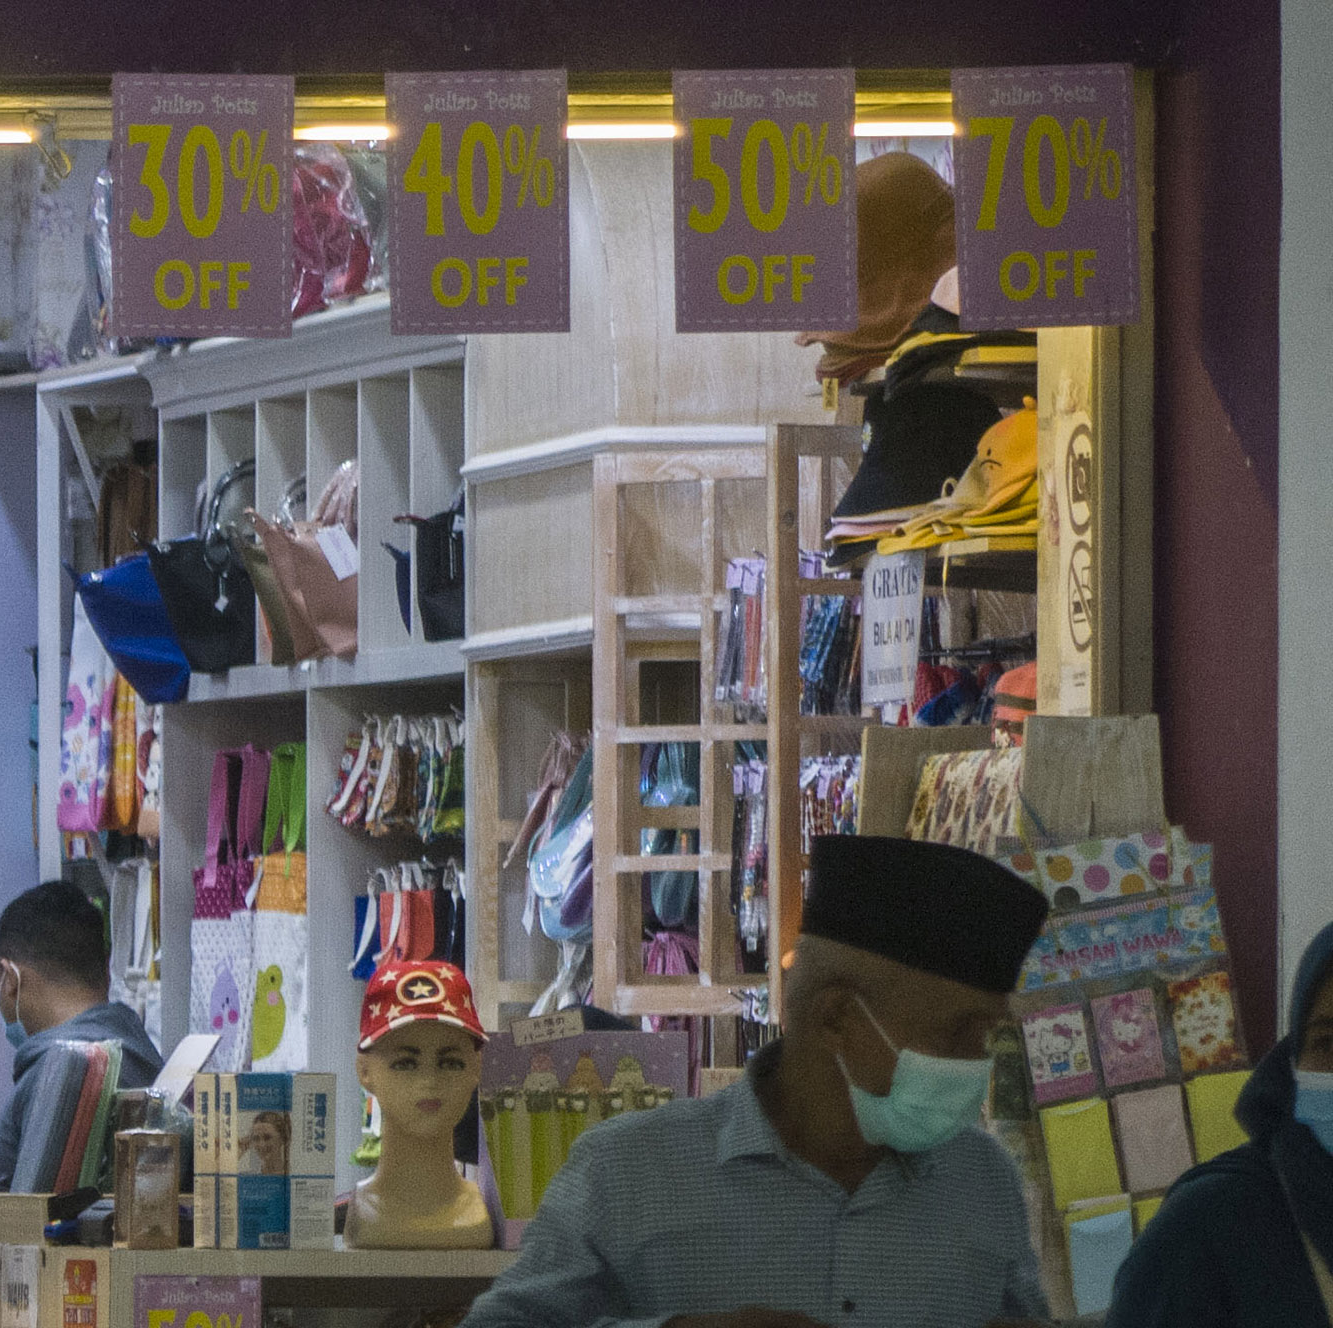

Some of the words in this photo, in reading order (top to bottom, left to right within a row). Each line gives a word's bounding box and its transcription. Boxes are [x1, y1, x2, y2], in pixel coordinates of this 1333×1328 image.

[424, 90, 478, 113] Julian
[485, 89, 531, 111] Potts
[128, 123, 280, 238] 30%
[403, 121, 555, 236] 40%
[687, 117, 842, 233] 50%
[968, 114, 1122, 231] 70%
[154, 260, 252, 310] OFF
[431, 256, 530, 308] OFF
[717, 254, 816, 305] OFF
[999, 249, 1097, 302] OFF
